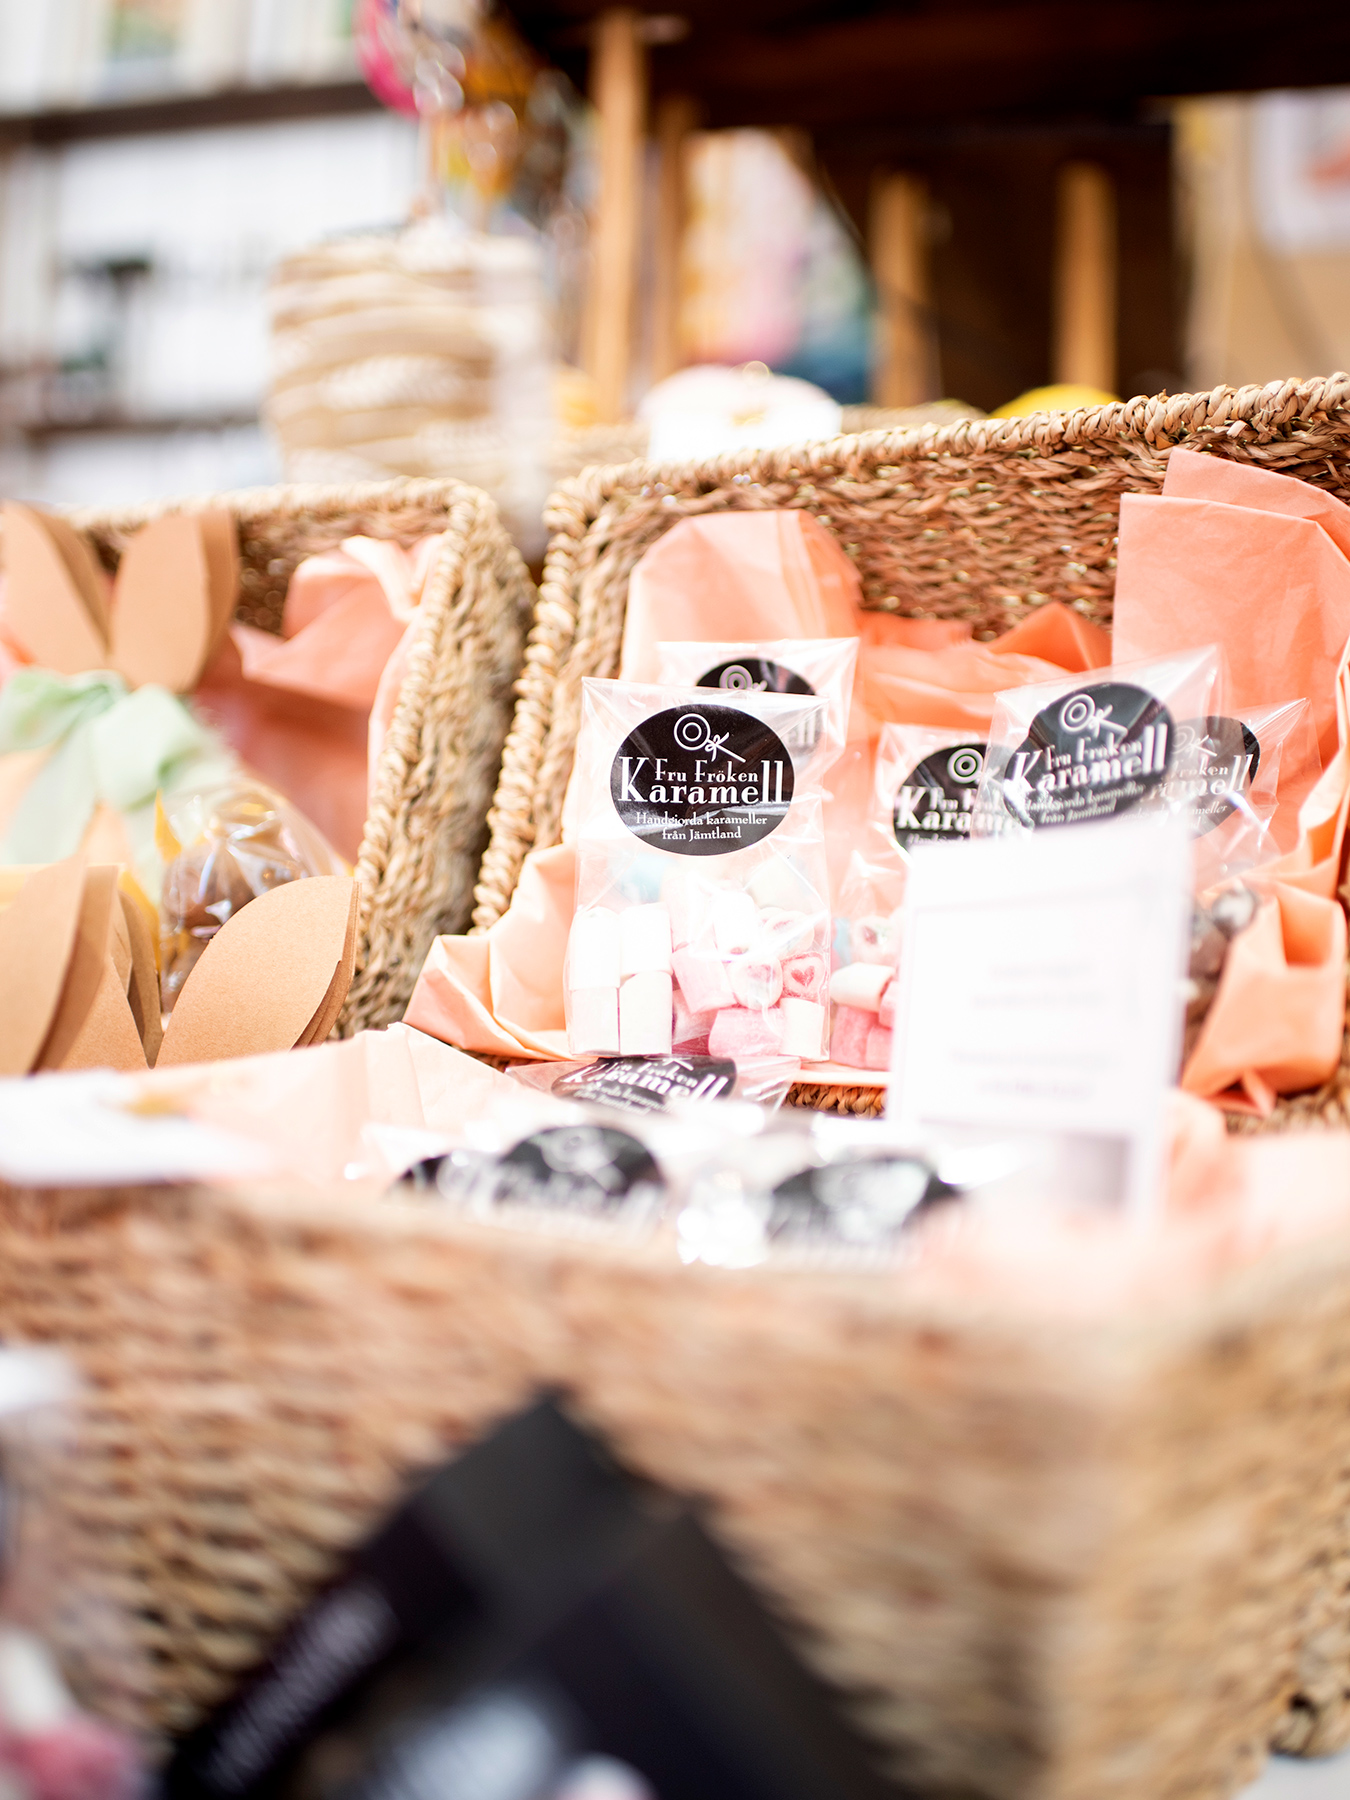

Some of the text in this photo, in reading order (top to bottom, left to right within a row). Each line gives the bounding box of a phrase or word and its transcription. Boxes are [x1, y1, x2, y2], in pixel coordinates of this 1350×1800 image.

[655, 758, 759, 783] Fru Fröken
[1007, 722, 1168, 794] Karamell
[618, 756, 784, 805] Karamell
[636, 811, 768, 828] Handgjorda karameller
[662, 826, 742, 842] från Jämtland
